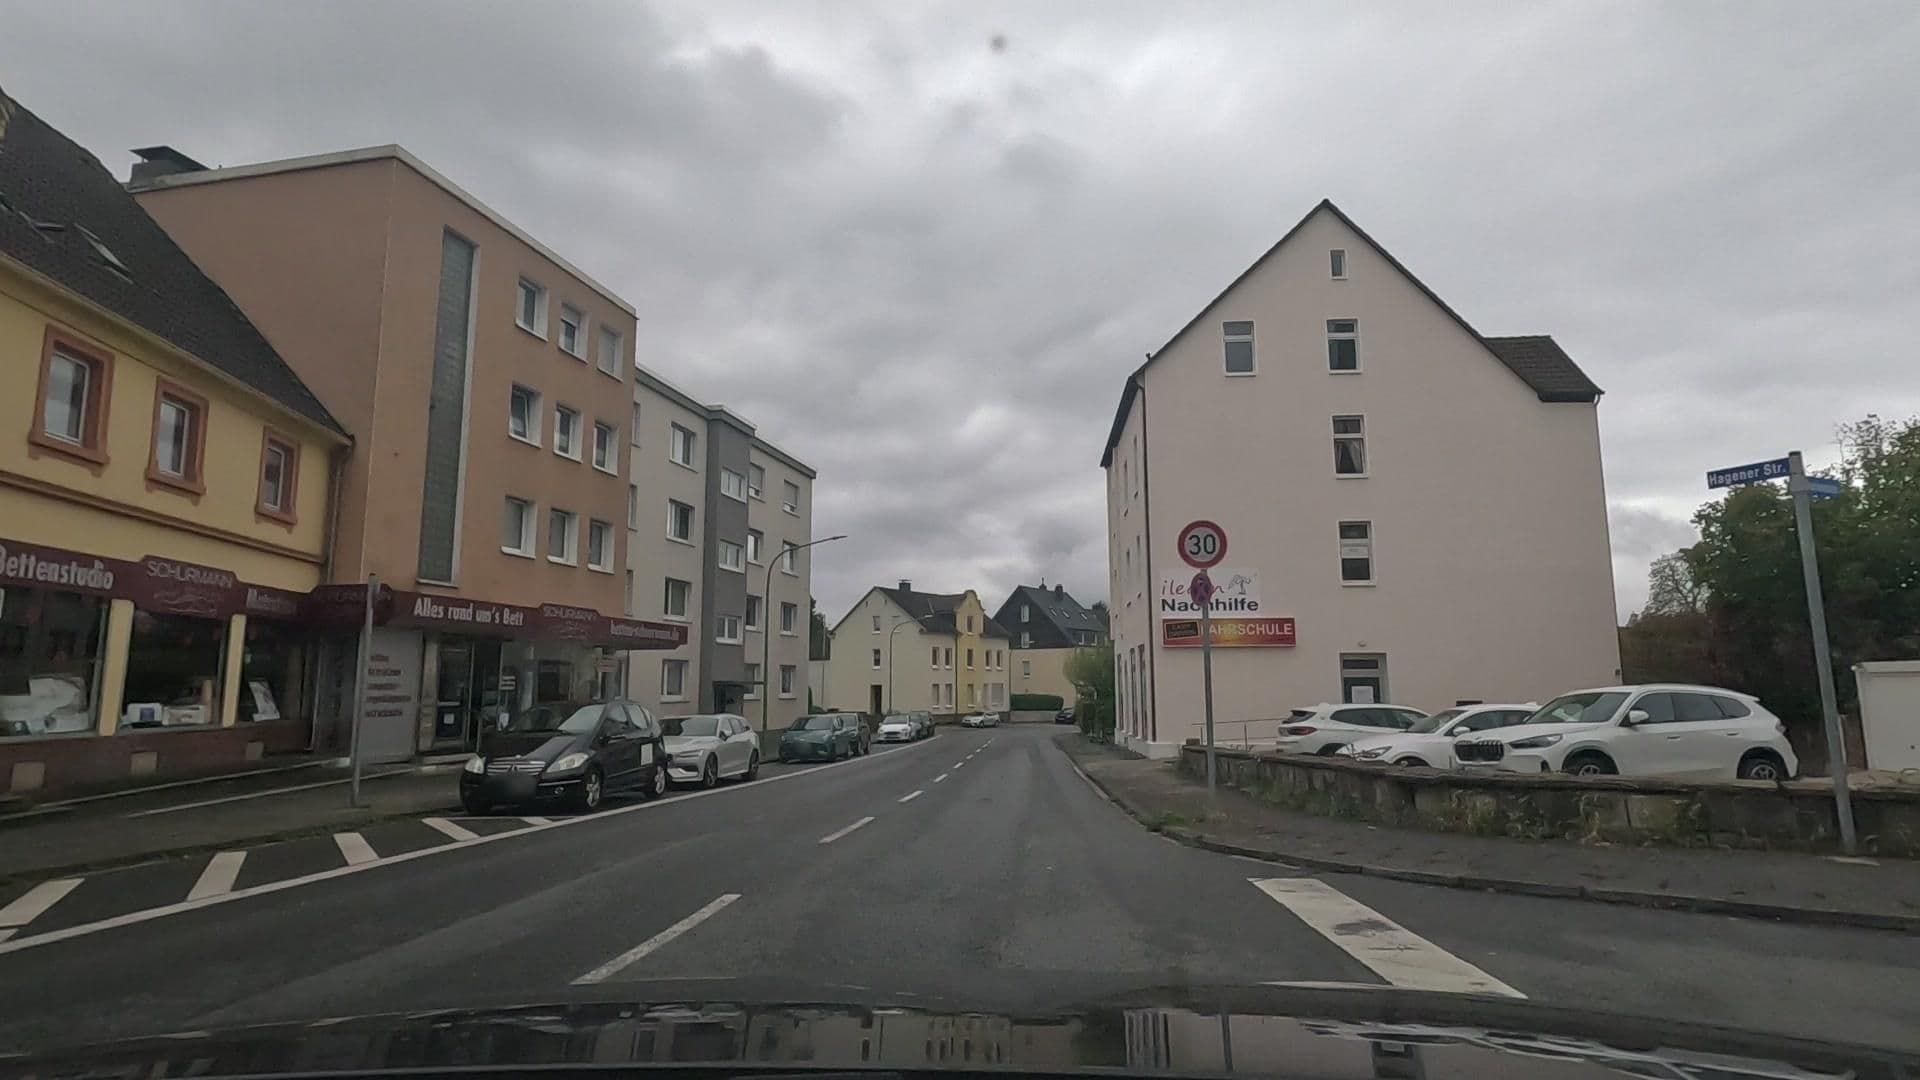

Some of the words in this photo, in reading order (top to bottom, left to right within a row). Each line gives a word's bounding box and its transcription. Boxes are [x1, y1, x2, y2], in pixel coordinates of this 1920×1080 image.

[1709, 469, 1758, 486] Hagener
[1763, 462, 1786, 476] Str.
[1188, 534, 1216, 555] 30
[1162, 580, 1224, 595] ilen
[413, 597, 443, 619] Alles
[447, 602, 473, 621] rund
[503, 607, 524, 626] Bett
